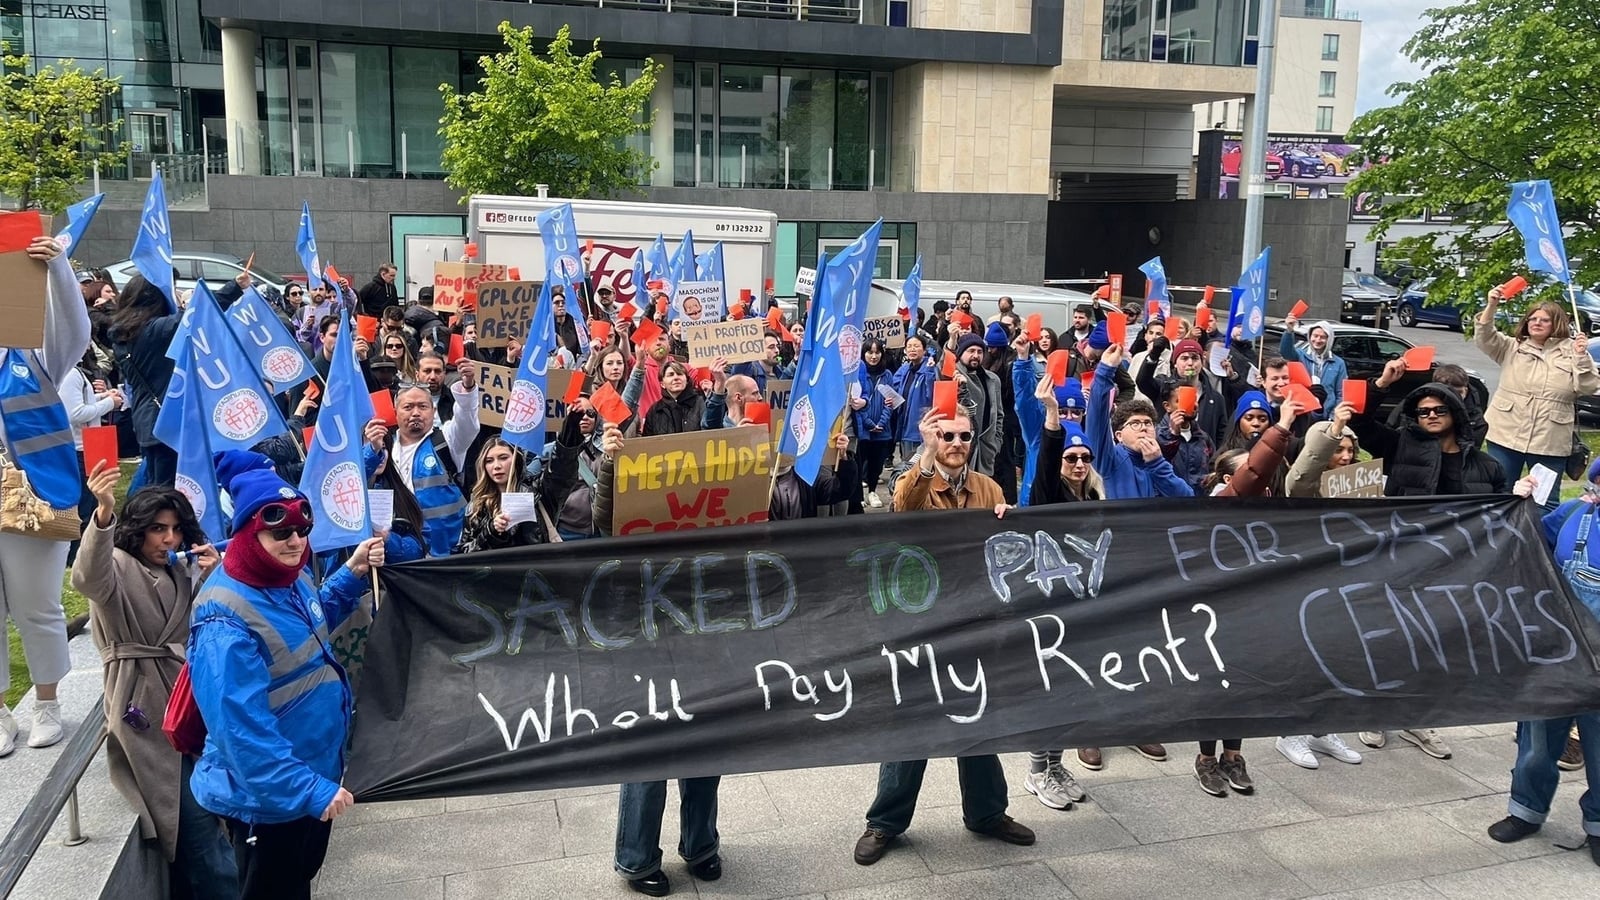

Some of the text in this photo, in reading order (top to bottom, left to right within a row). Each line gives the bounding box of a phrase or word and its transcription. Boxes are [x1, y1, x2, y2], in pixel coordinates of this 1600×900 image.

[33, 4, 107, 20] CHASE
[480, 287, 510, 307] CPL
[501, 305, 529, 320] WE
[863, 319, 900, 331] JOBS GO
[481, 318, 533, 339] RESI
[694, 339, 765, 358] HUMAN COST
[617, 450, 700, 493] META
[1327, 467, 1381, 497] Bills Rise
[666, 488, 730, 521] WE
[451, 504, 1526, 664] SACKED TO PAY FOR DATA
[1300, 582, 1577, 696] CENTRES
[756, 659, 853, 722] Pay
[882, 642, 986, 724] My
[1025, 602, 1231, 691] Rent?
